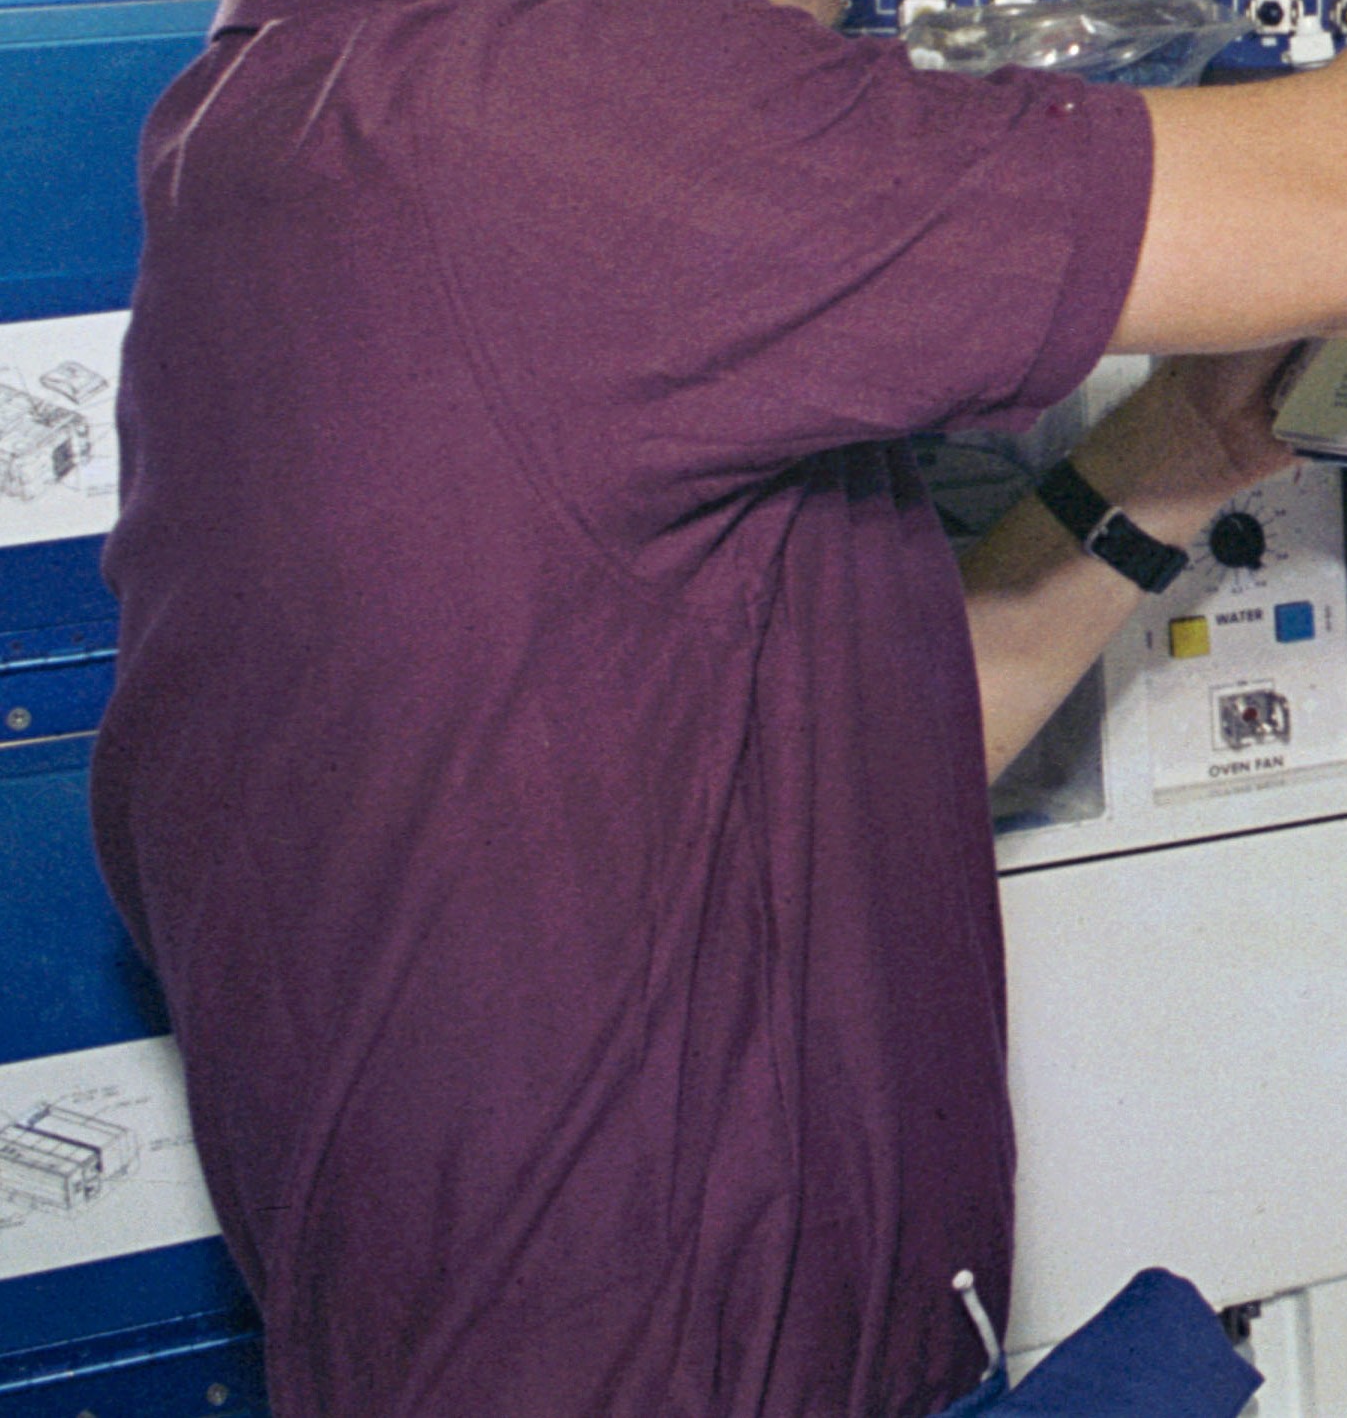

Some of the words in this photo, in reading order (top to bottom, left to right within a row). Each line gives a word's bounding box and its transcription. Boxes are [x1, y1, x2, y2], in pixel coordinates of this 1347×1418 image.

[1215, 608, 1265, 627] WATER
[1208, 760, 1251, 779] OVEN
[1254, 755, 1285, 771] FAN
